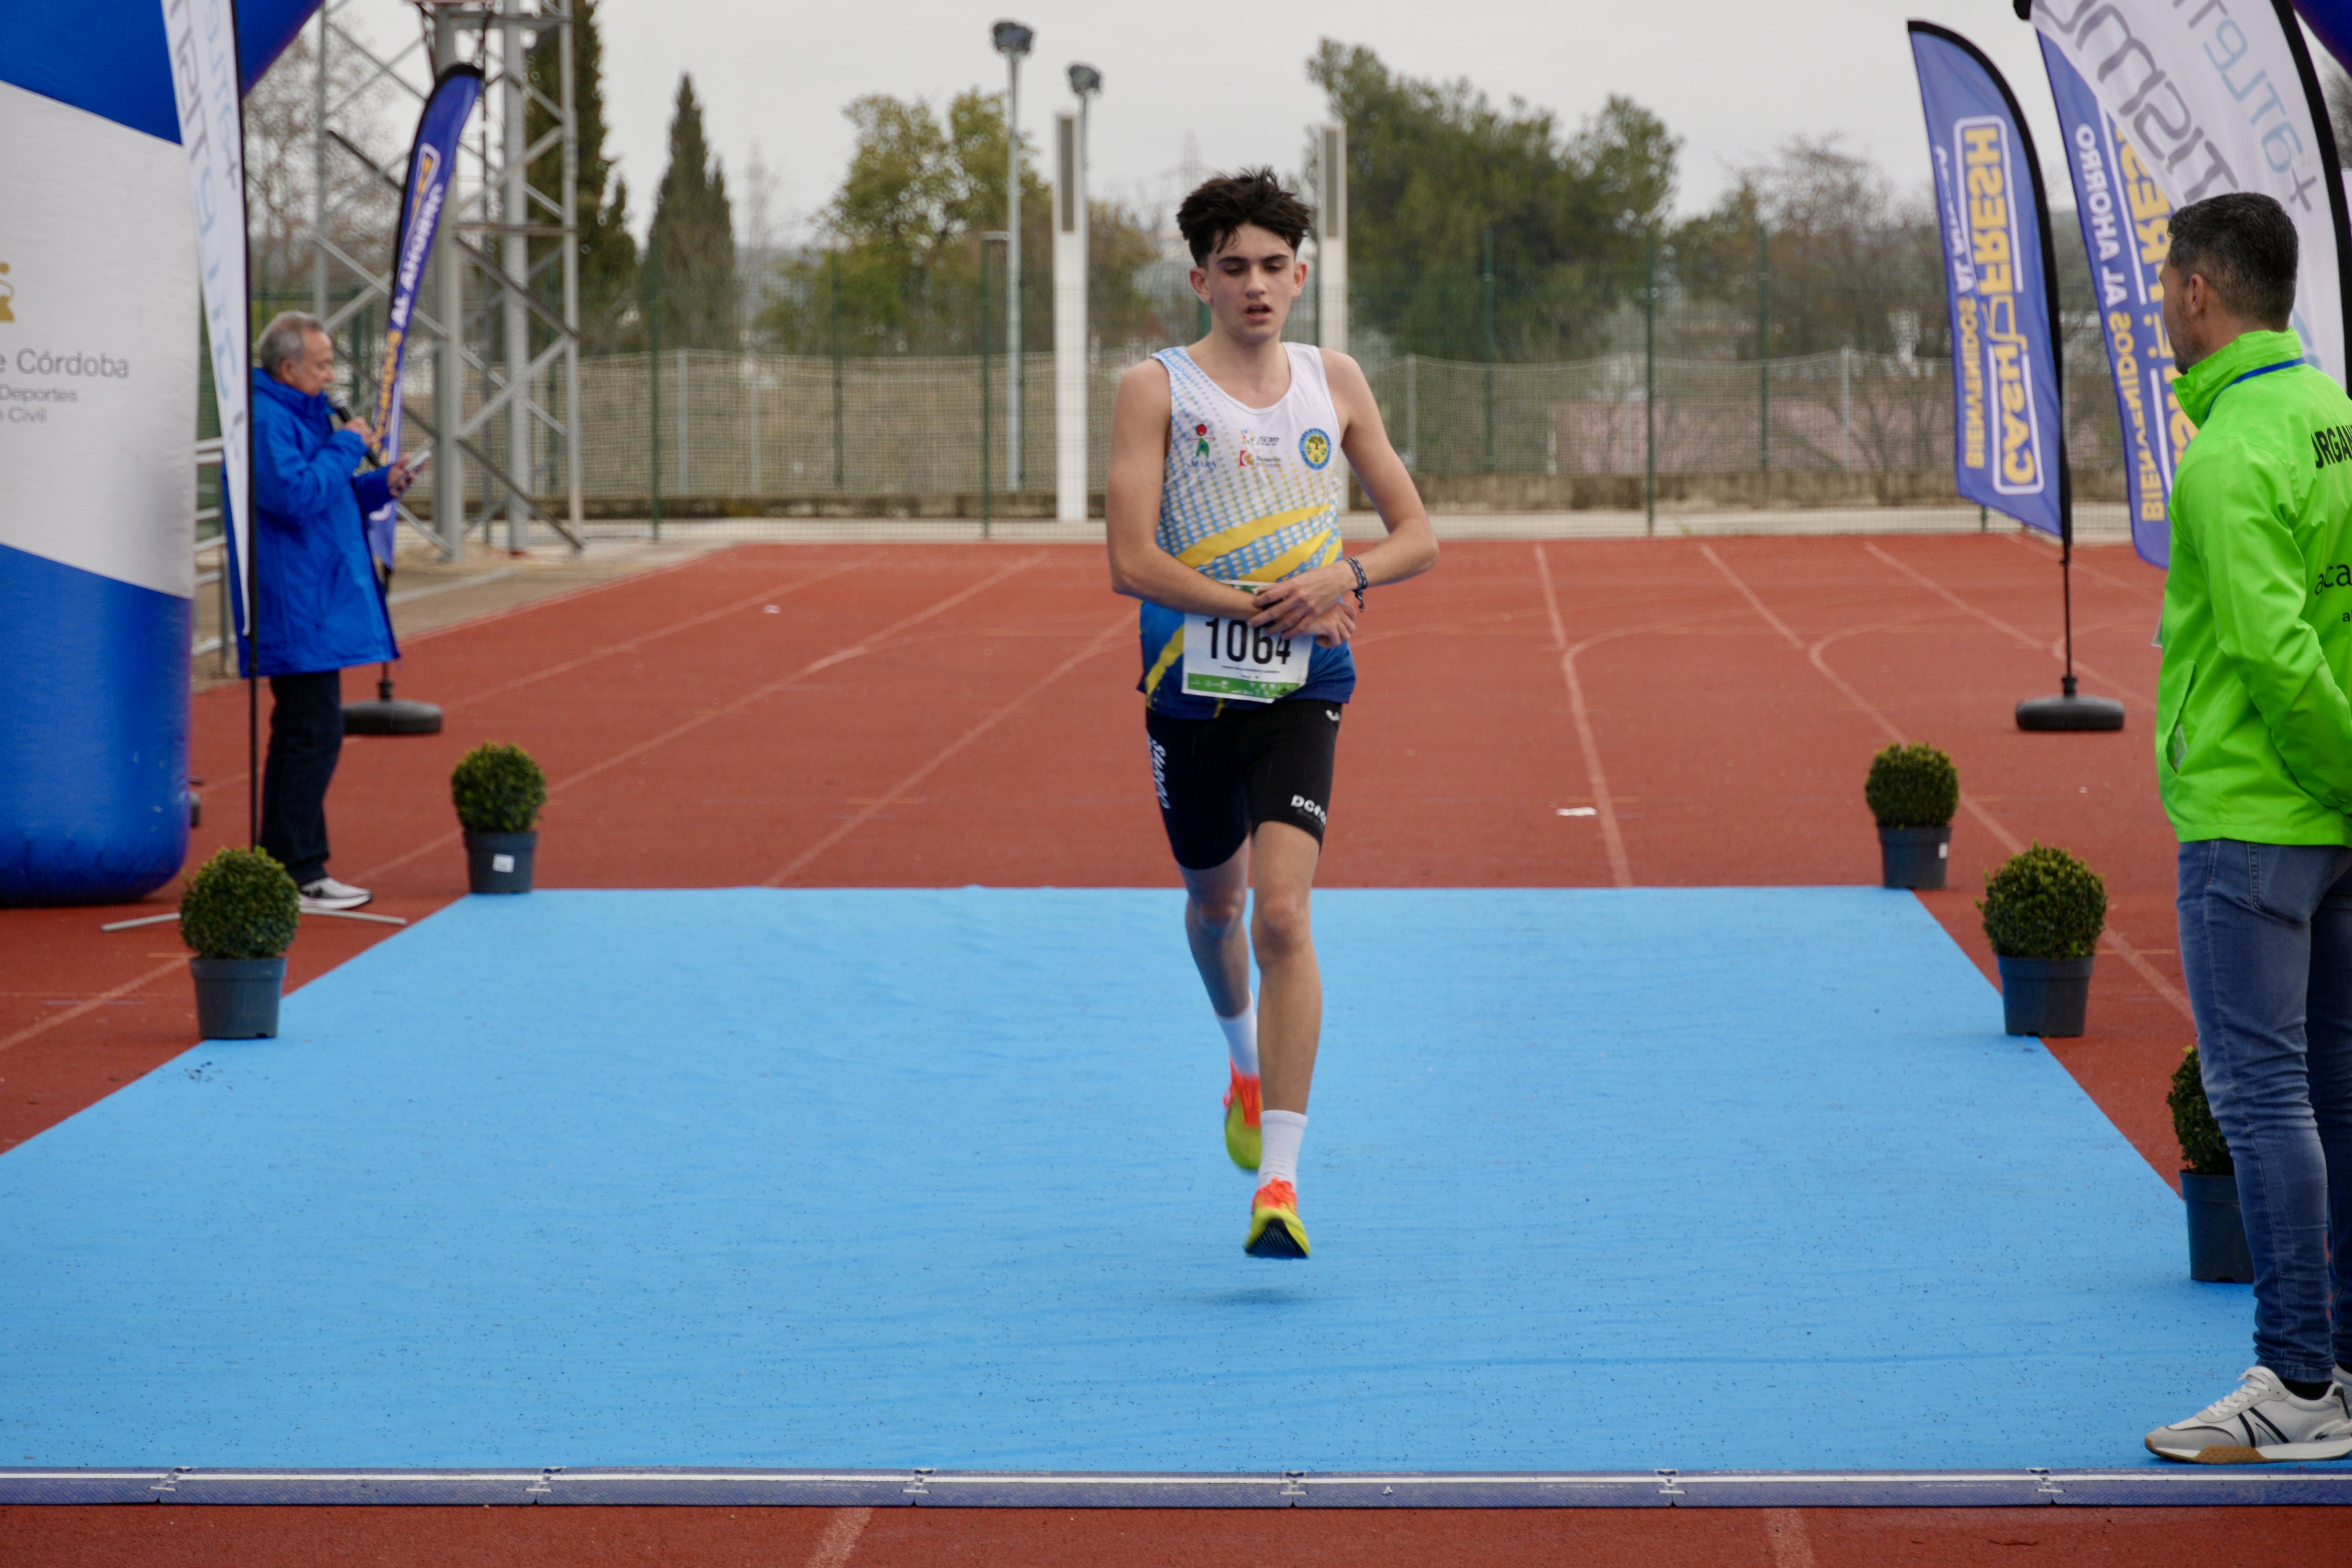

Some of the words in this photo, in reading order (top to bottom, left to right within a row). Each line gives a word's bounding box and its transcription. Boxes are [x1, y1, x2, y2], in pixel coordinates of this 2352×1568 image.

[391, 292, 410, 329] AL
[16, 347, 130, 379] Córdoba
[0, 383, 79, 404] Deportes
[8, 405, 47, 424] Civil
[1205, 617, 1291, 664] 1064
